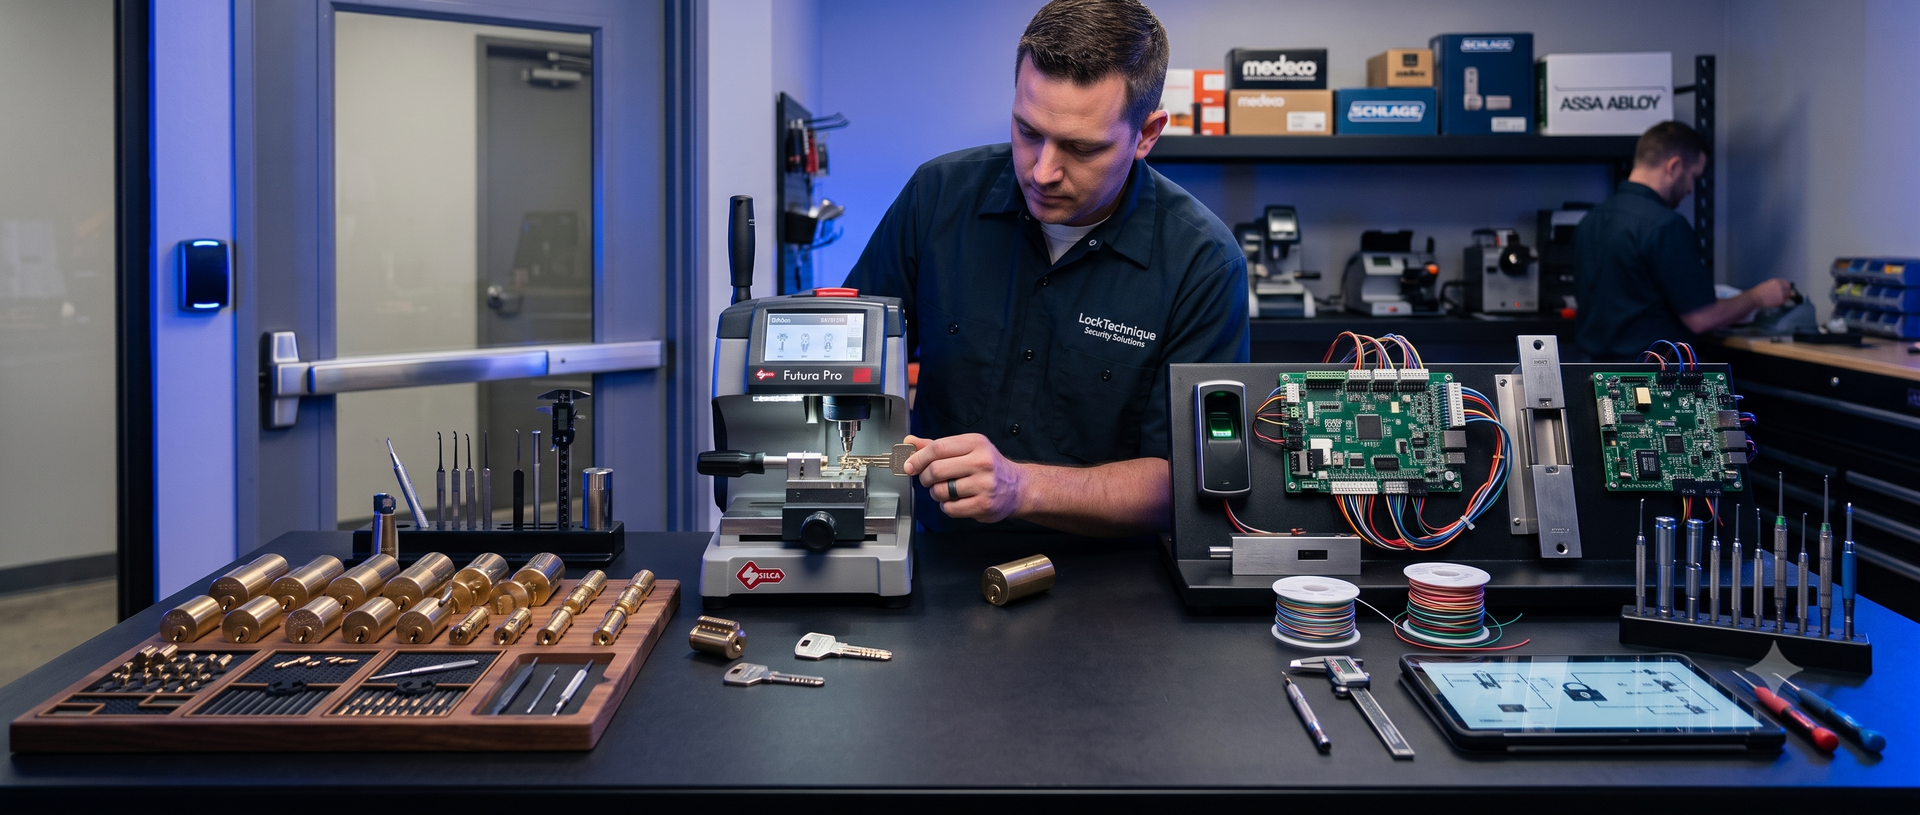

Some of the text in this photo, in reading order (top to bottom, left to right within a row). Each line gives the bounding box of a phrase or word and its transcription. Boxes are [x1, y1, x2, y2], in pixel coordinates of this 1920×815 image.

[1462, 39, 1511, 49] SCHLAGE
[1242, 54, 1317, 77] medeco
[1237, 93, 1285, 107] medeco
[1559, 95, 1661, 110] ASSA ABLOY
[1350, 105, 1421, 118] SCHLAGE
[1078, 312, 1157, 341] LockTechnique
[1084, 326, 1146, 348] Security Solutions
[783, 369, 819, 381] Futura
[823, 369, 843, 381] Pro
